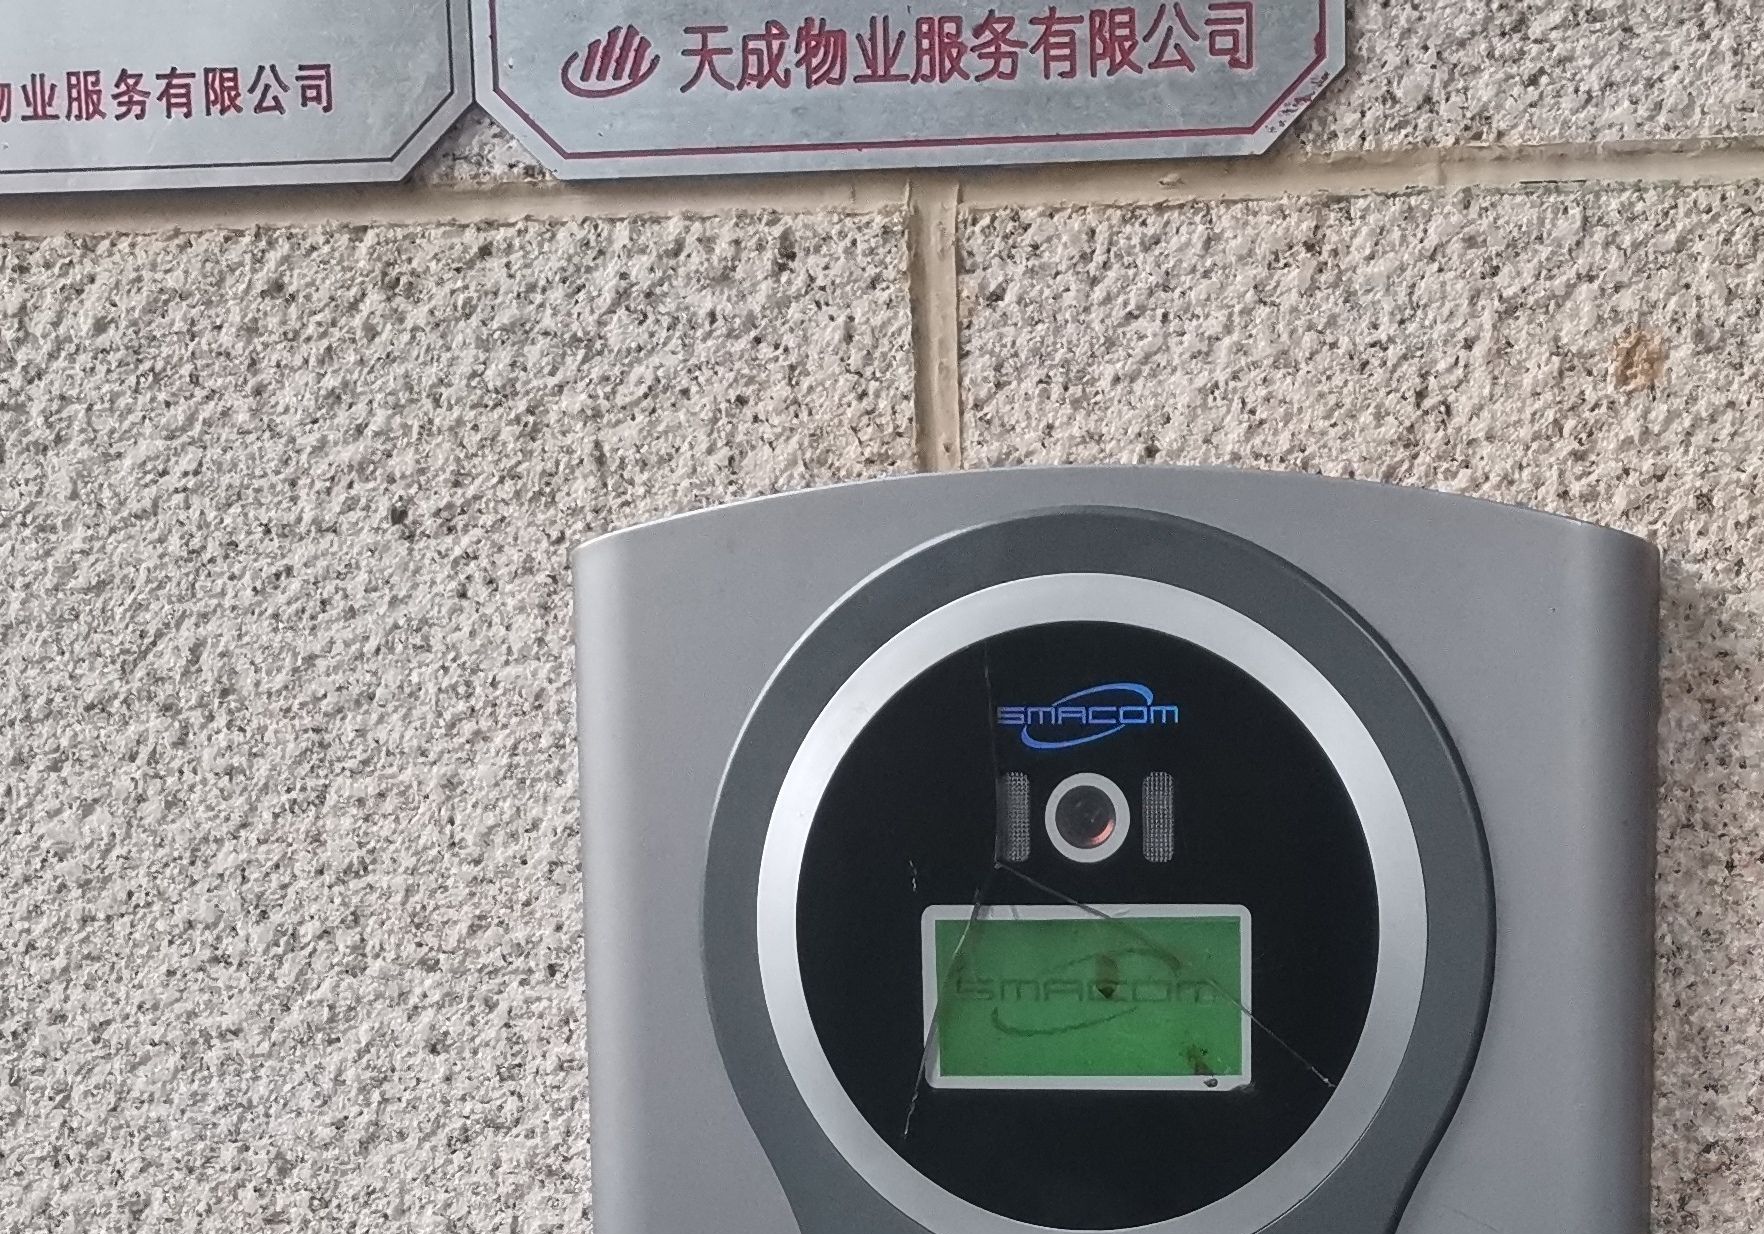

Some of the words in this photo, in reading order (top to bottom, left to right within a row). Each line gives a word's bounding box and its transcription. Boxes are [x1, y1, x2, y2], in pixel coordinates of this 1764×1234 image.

[680, 2, 1254, 93] 天成物业服务有限公司
